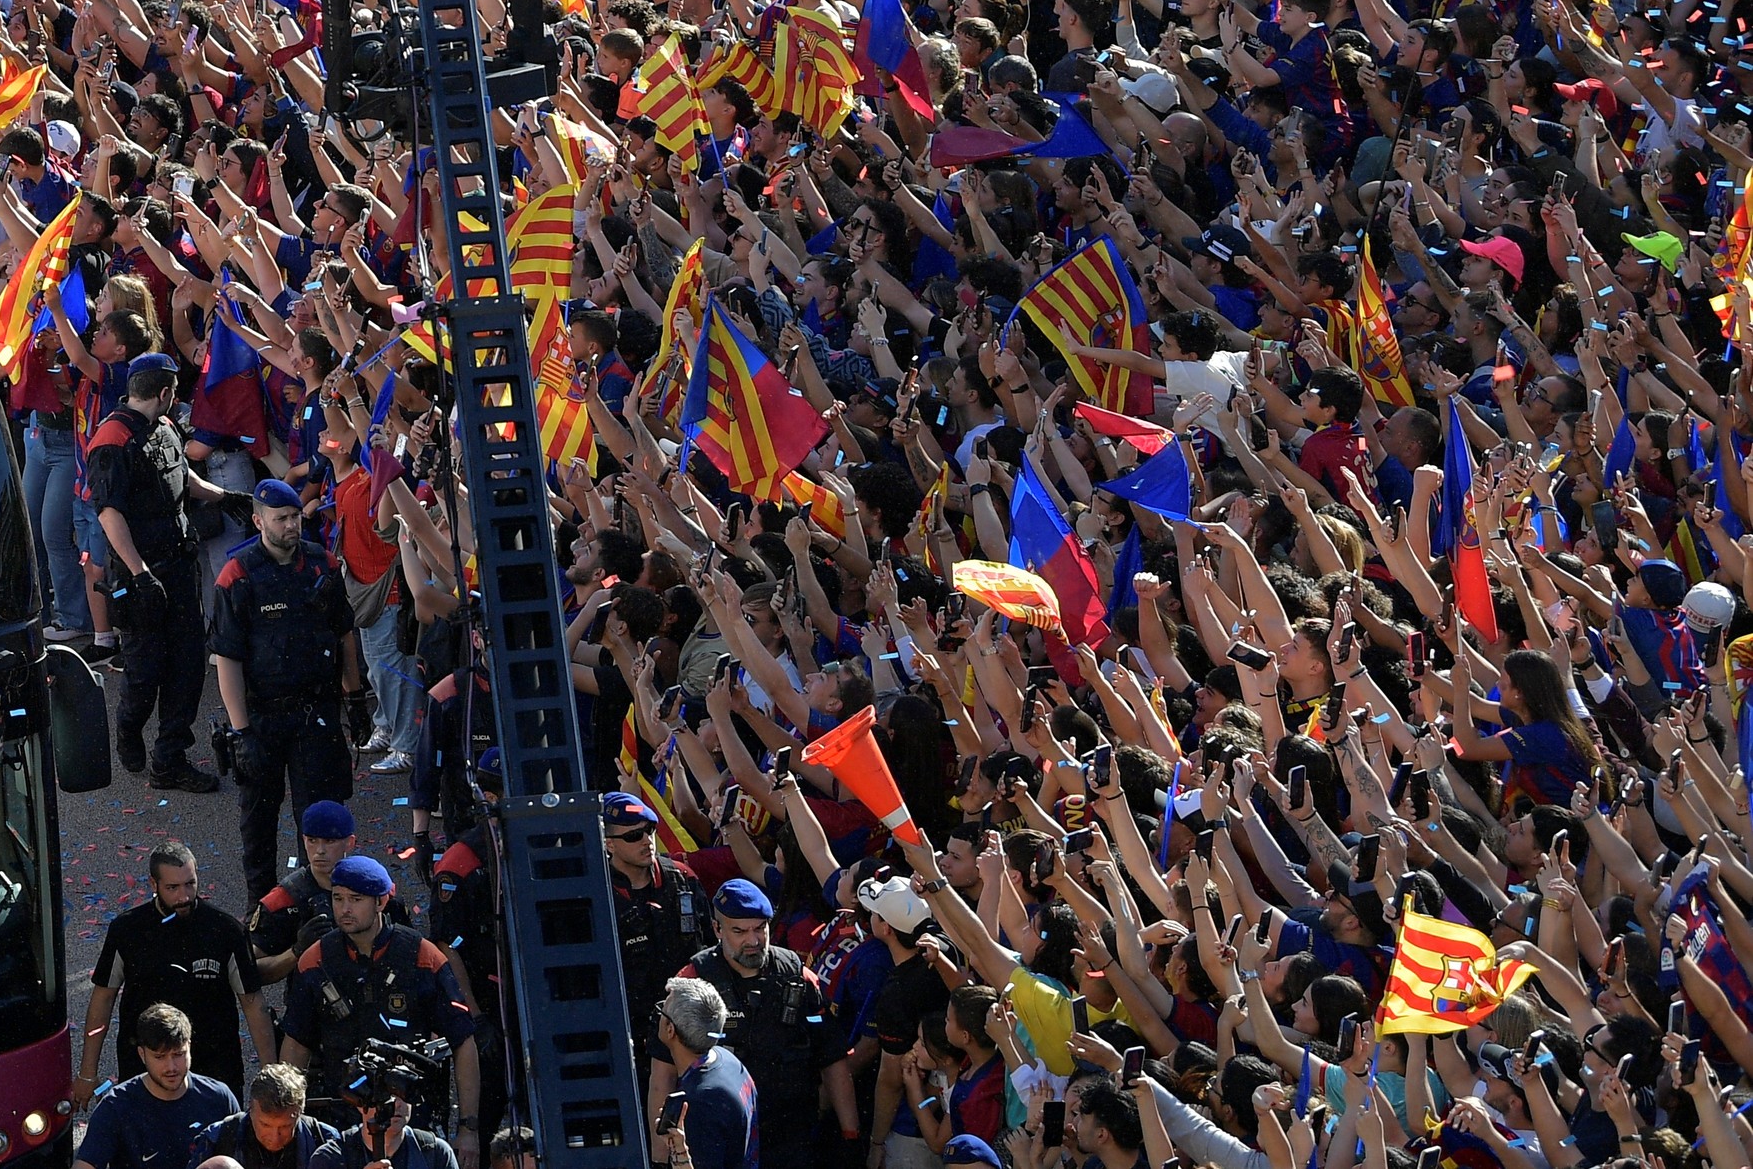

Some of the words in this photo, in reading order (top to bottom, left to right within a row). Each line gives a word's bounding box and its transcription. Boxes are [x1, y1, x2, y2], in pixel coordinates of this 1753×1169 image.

[1369, 335, 1387, 360] FCB
[260, 602, 288, 613] POLICIA
[472, 735, 490, 743] OLICIA
[626, 935, 648, 946] POLICIA
[1686, 921, 1711, 960] akuten
[817, 952, 842, 985] FC
[726, 1011, 745, 1020] ICIA
